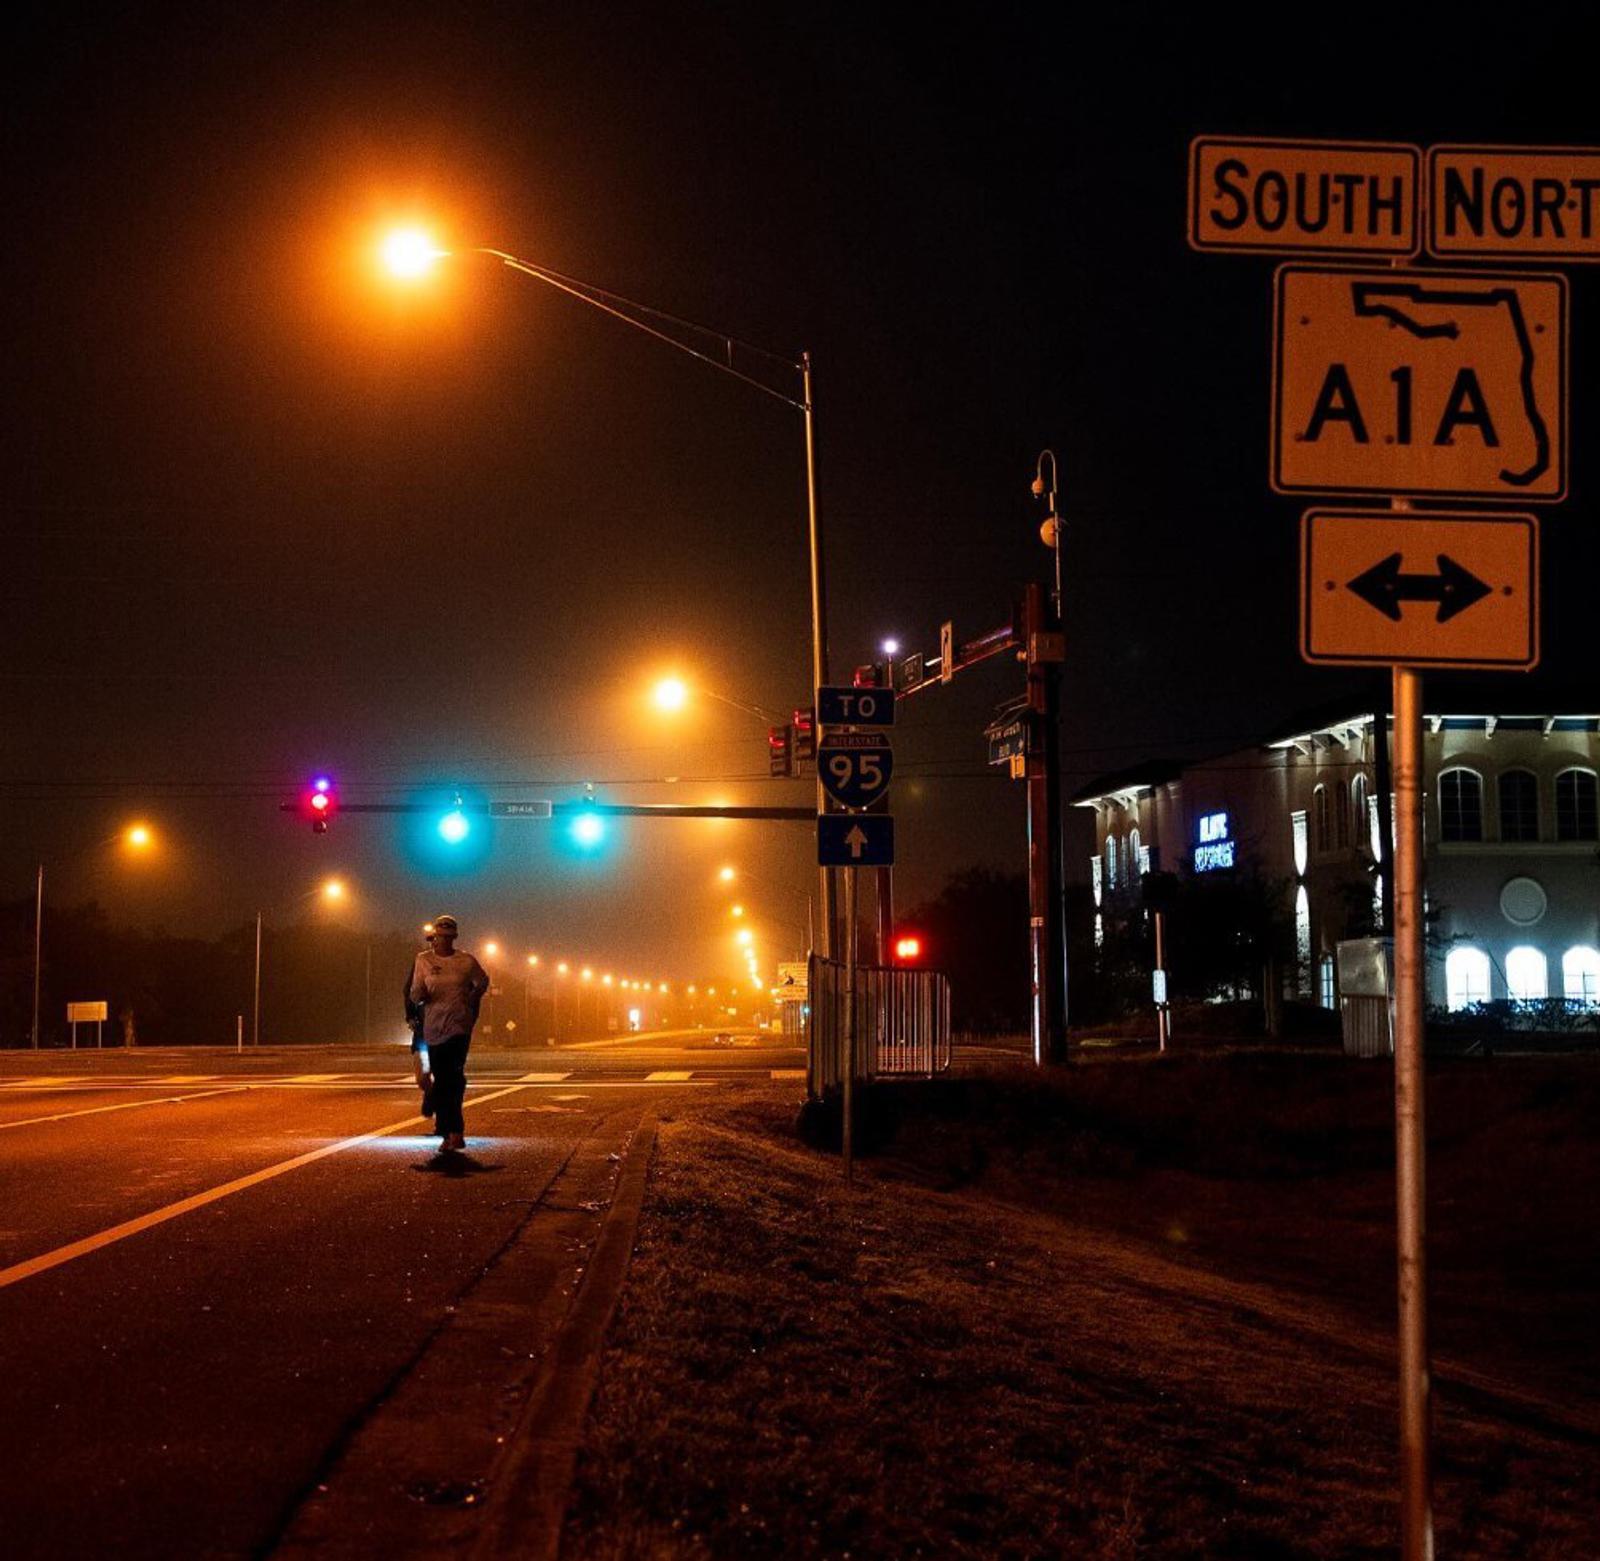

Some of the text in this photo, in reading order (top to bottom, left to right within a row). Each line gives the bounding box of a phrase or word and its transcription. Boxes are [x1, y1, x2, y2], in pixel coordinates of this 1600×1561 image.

[1210, 159, 1402, 236] SOUTH
[1304, 364, 1498, 446] A1A
[838, 695, 876, 718] TO
[829, 755, 883, 790] 95
